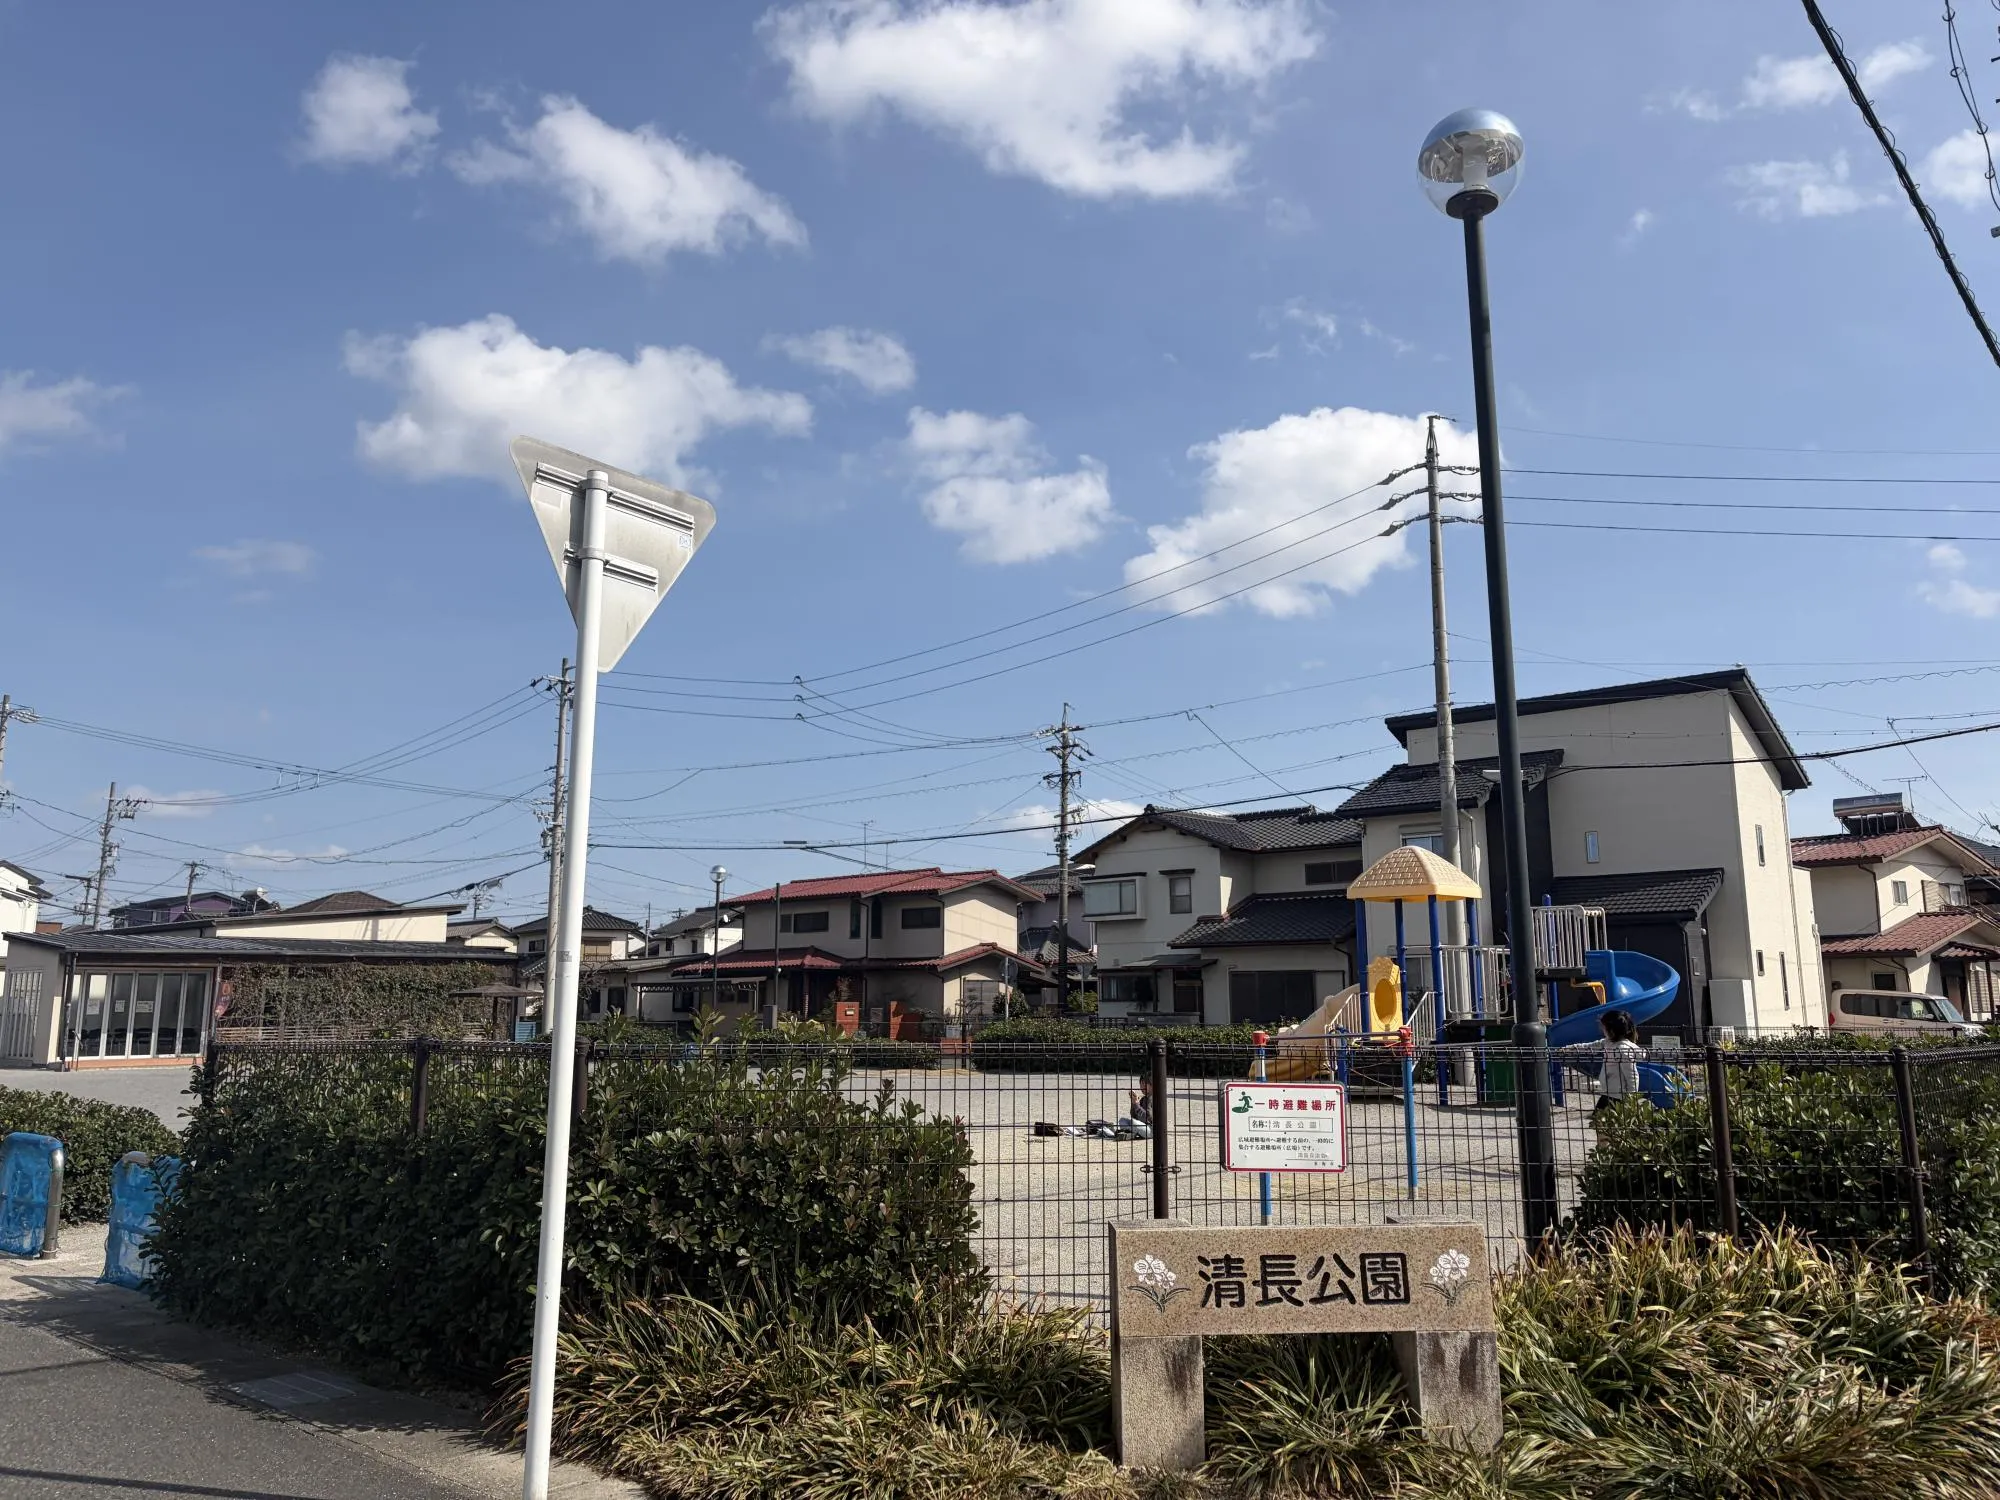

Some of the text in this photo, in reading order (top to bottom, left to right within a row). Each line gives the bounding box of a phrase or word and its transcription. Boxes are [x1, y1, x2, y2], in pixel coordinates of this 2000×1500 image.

[1254, 1098, 1336, 1112] 一時避難場所
[1197, 1252, 1410, 1309] 清長公園
